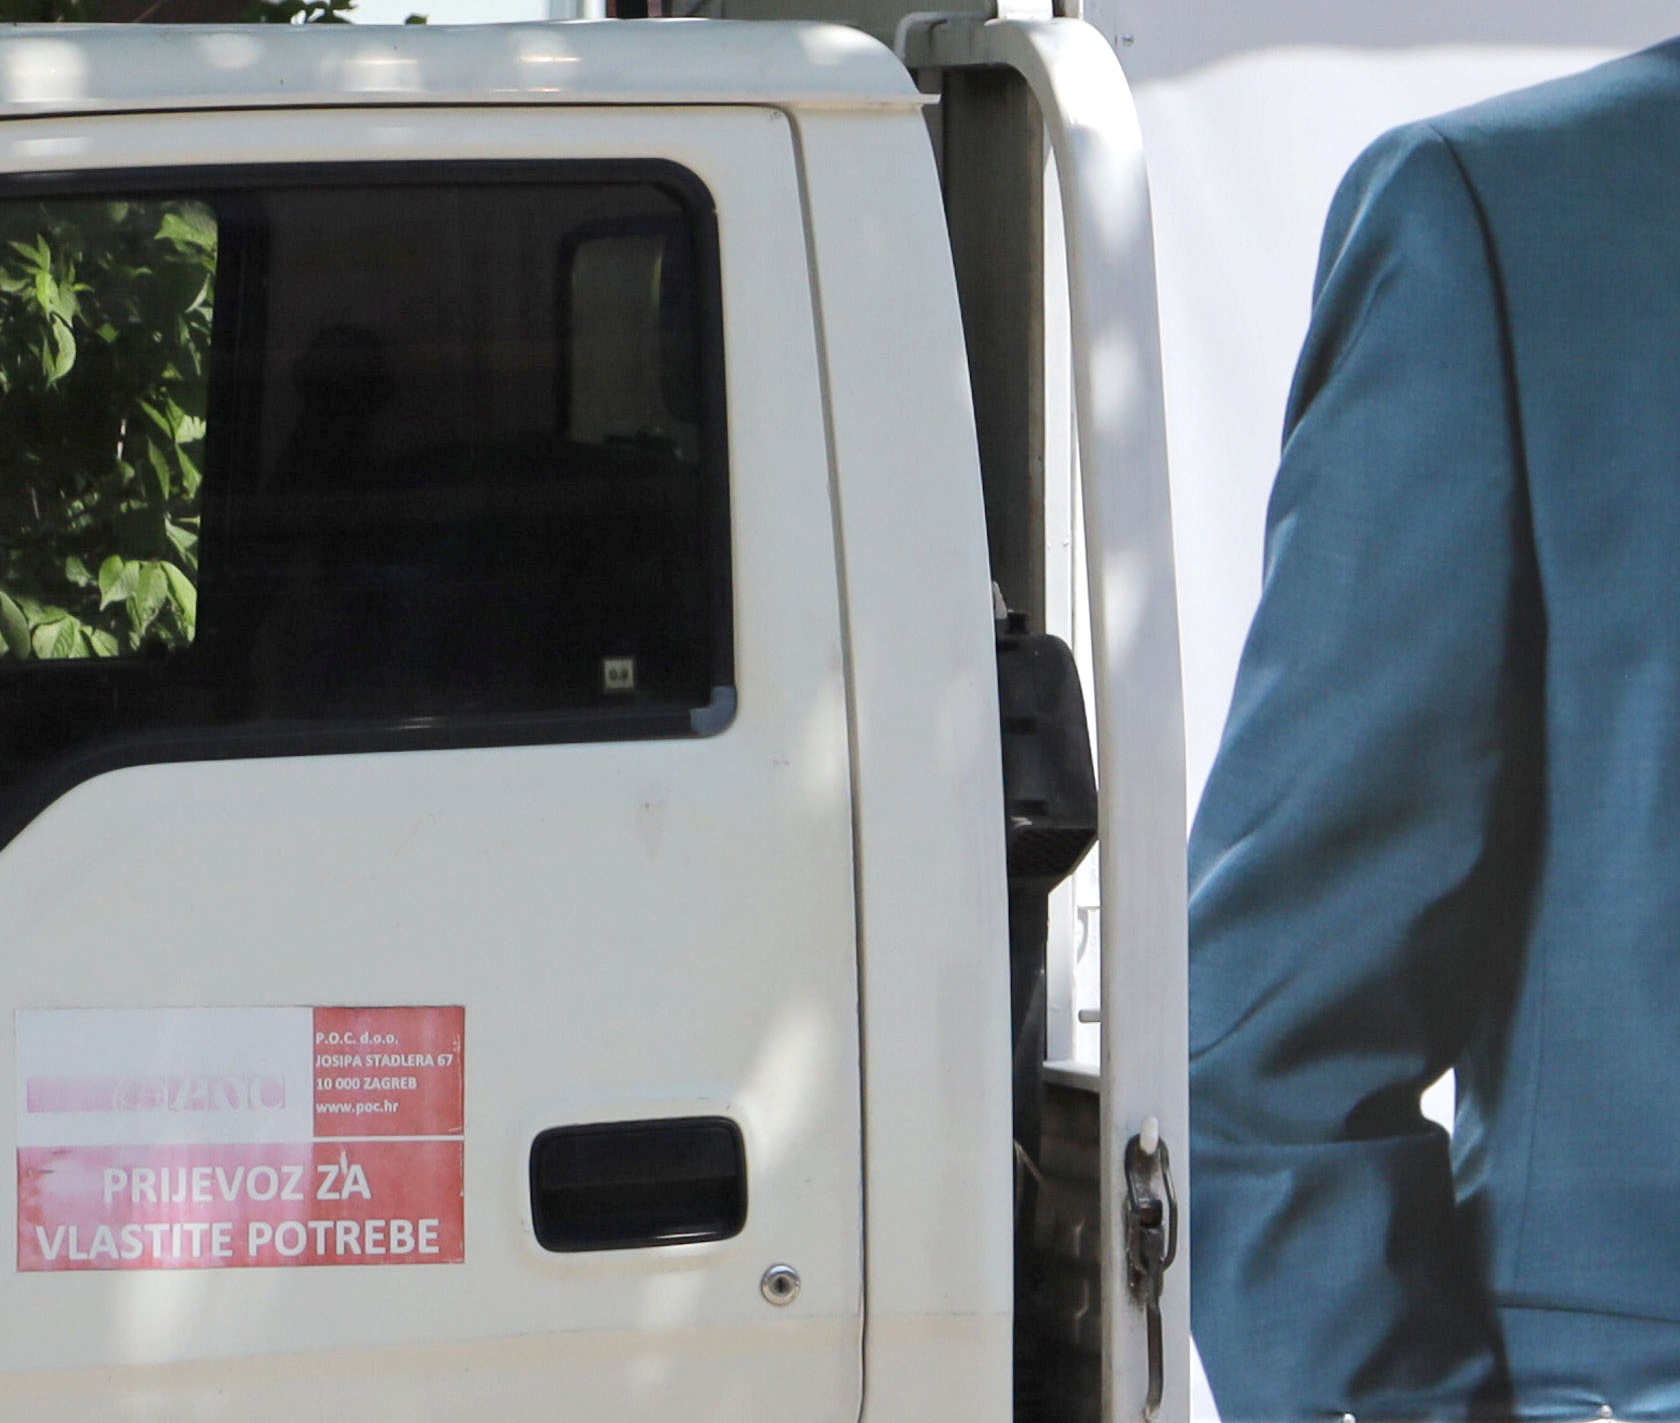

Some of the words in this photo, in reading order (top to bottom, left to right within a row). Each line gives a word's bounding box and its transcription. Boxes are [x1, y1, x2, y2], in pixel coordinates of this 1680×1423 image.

[316, 1032, 356, 1045] P.O.C.
[360, 1031, 399, 1045] d.o.o.
[316, 1054, 363, 1067] JOSIPA
[366, 1053, 434, 1067] STADLERA
[437, 1053, 454, 1066] 67
[317, 1078, 332, 1090] 10
[336, 1077, 361, 1090] 000
[363, 1077, 418, 1090] ZAGREB
[316, 1099, 399, 1115] www.poc.hr
[104, 1165, 304, 1203] PRIJEVOZ
[316, 1163, 372, 1200] ZA
[35, 1223, 233, 1260] VLASTITE
[247, 1218, 440, 1258] POTREBE
